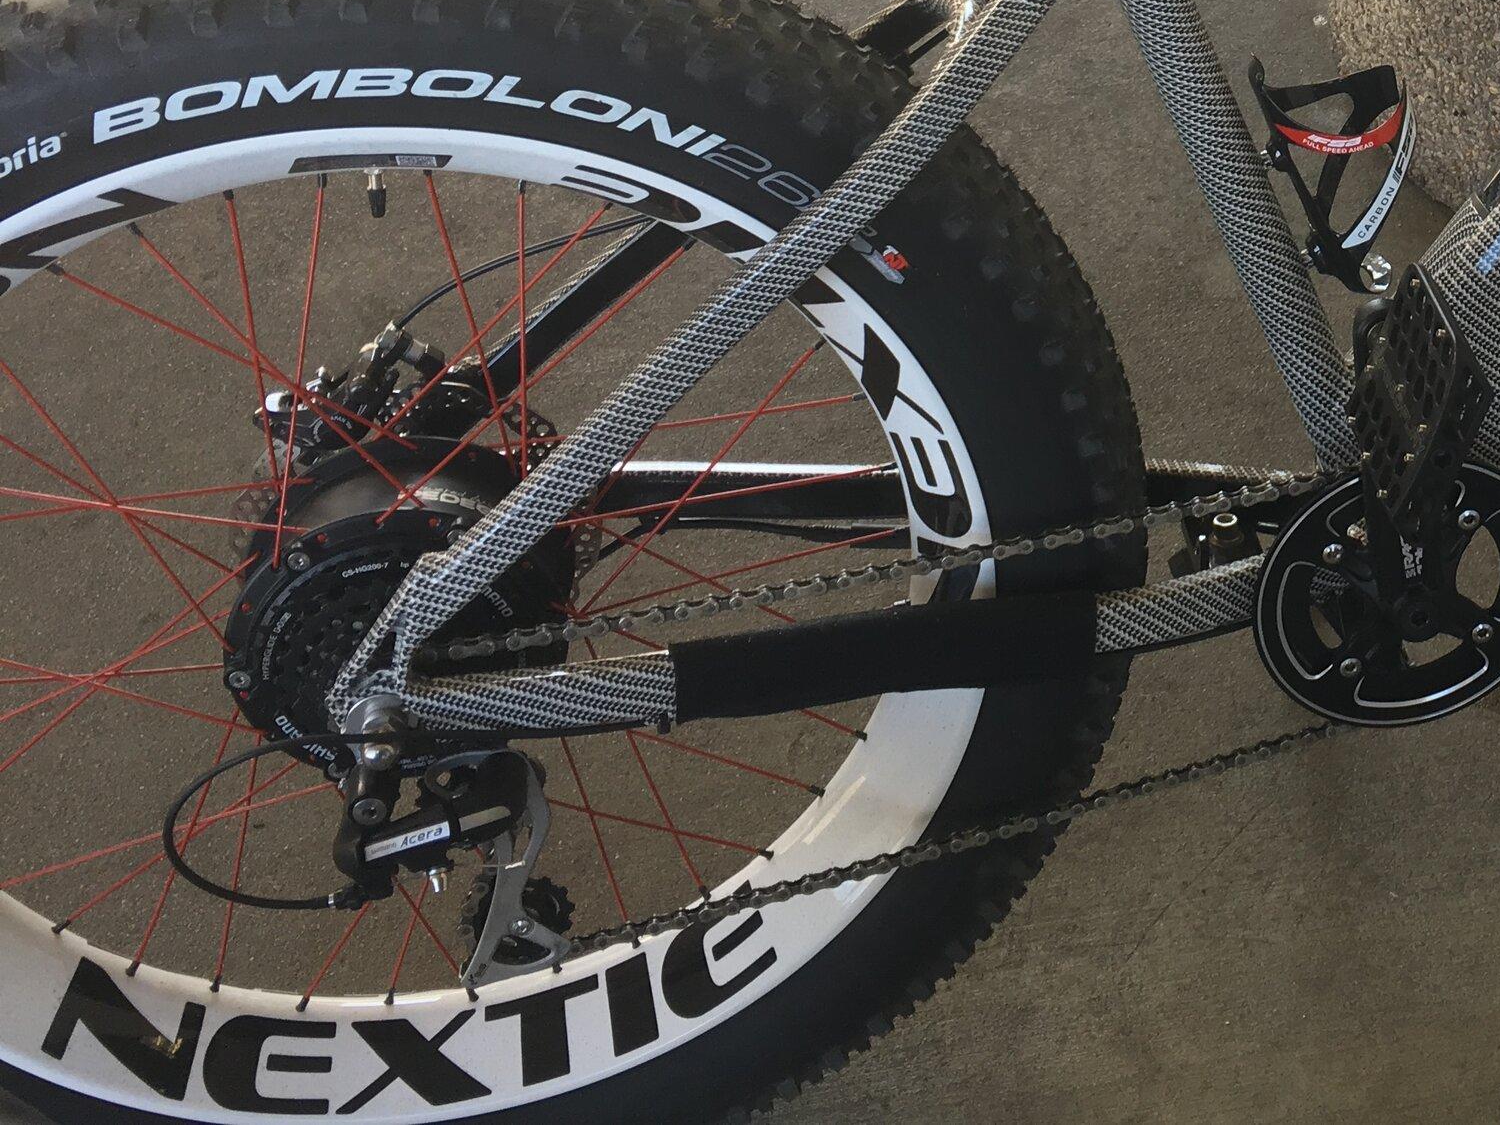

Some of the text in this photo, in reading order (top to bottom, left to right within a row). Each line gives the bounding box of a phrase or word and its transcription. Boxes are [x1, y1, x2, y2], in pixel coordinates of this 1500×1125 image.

[1321, 146, 1347, 154] SPEED
[1348, 141, 1375, 154] AHEAD
[1357, 185, 1396, 240] CARBON
[400, 825, 444, 848] Acera
[41, 879, 778, 1115] NEXTIE
